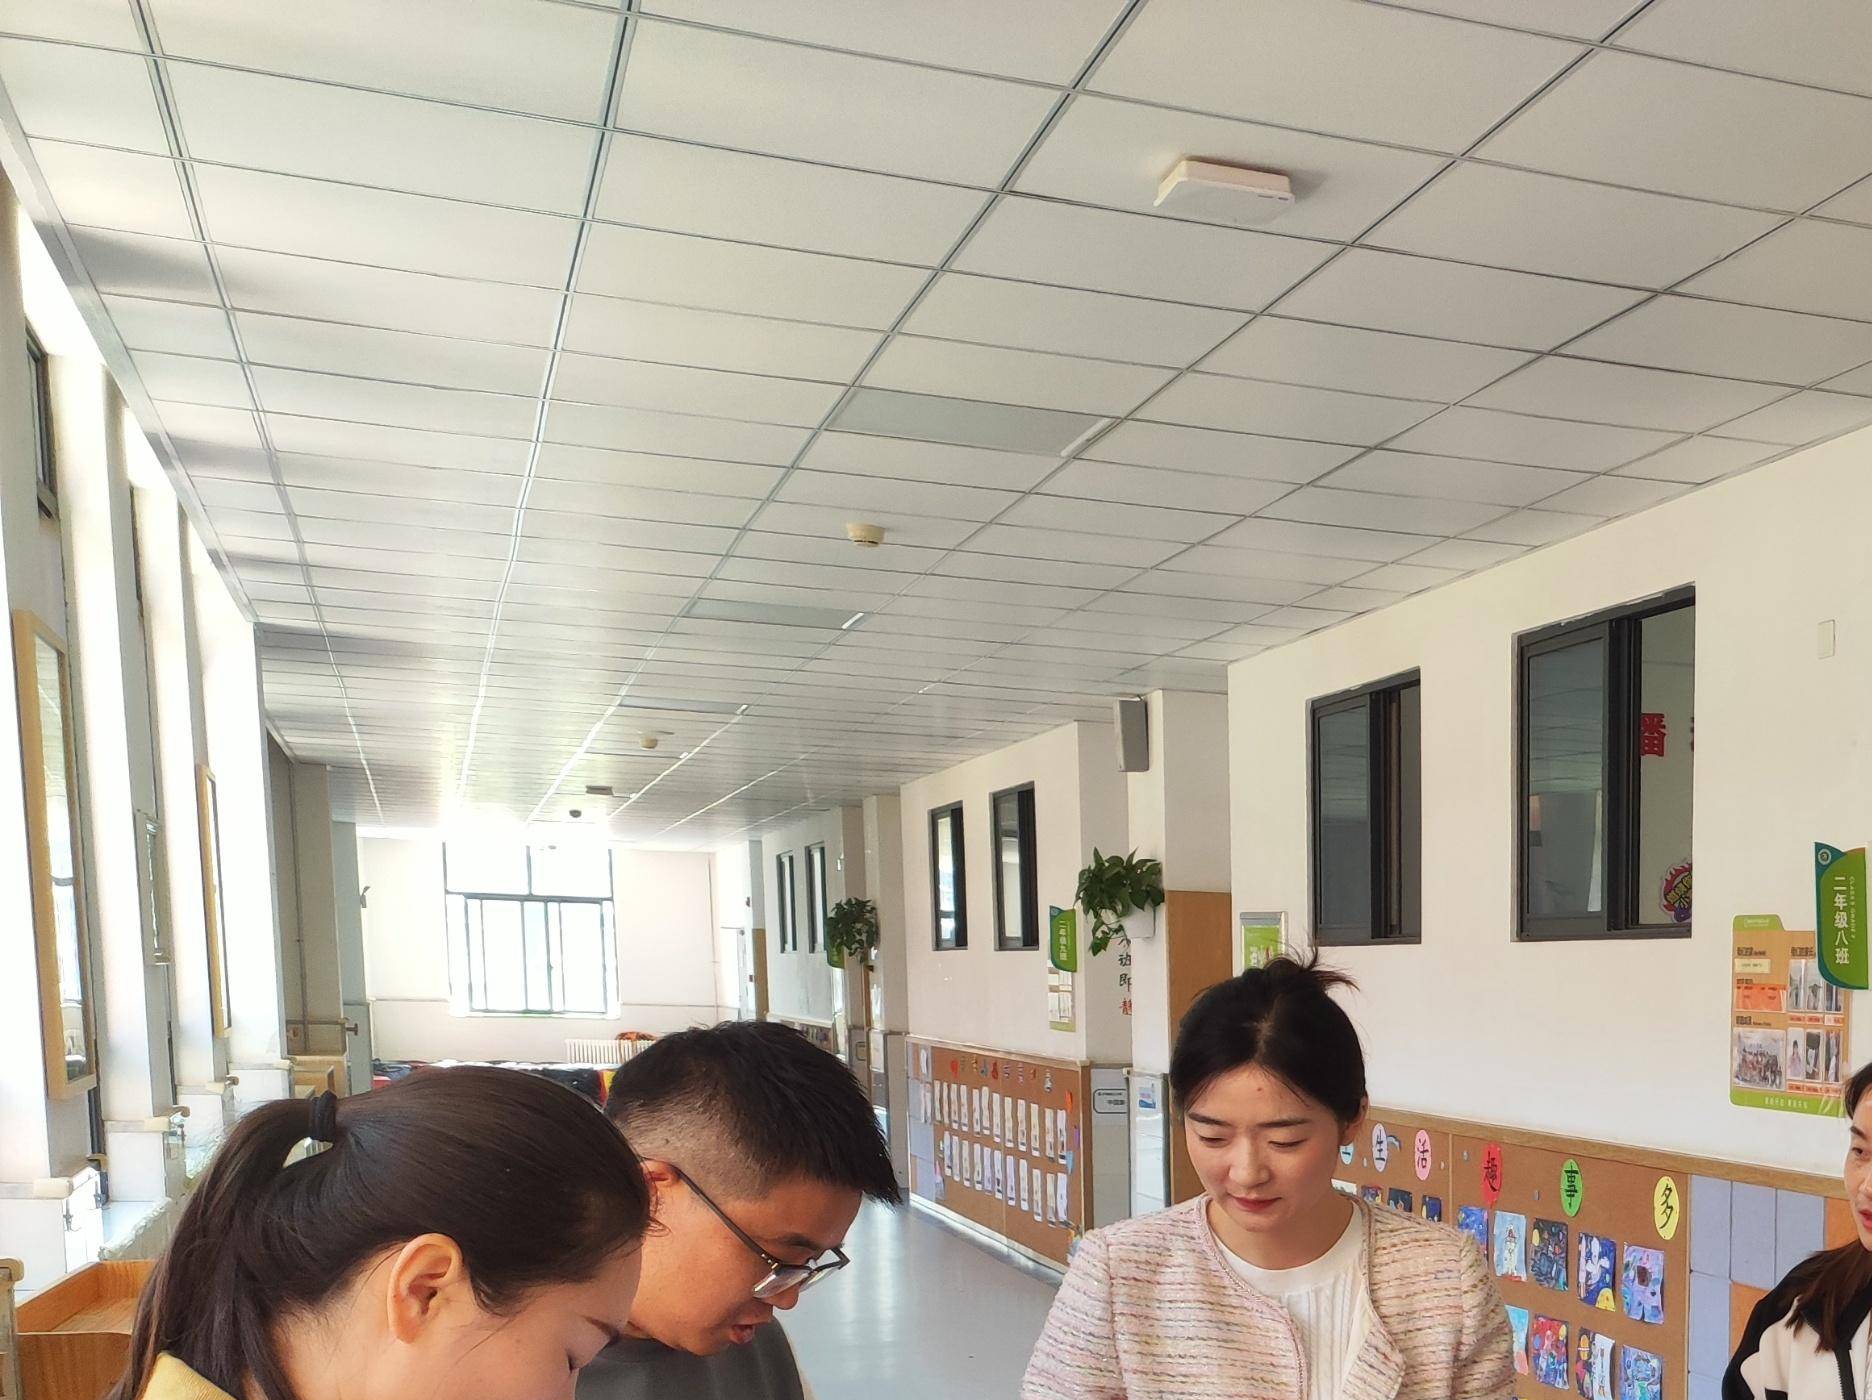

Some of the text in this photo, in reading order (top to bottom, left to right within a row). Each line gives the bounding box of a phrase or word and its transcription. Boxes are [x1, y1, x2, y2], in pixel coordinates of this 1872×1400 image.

[1833, 876, 1850, 965] 二年级八班
